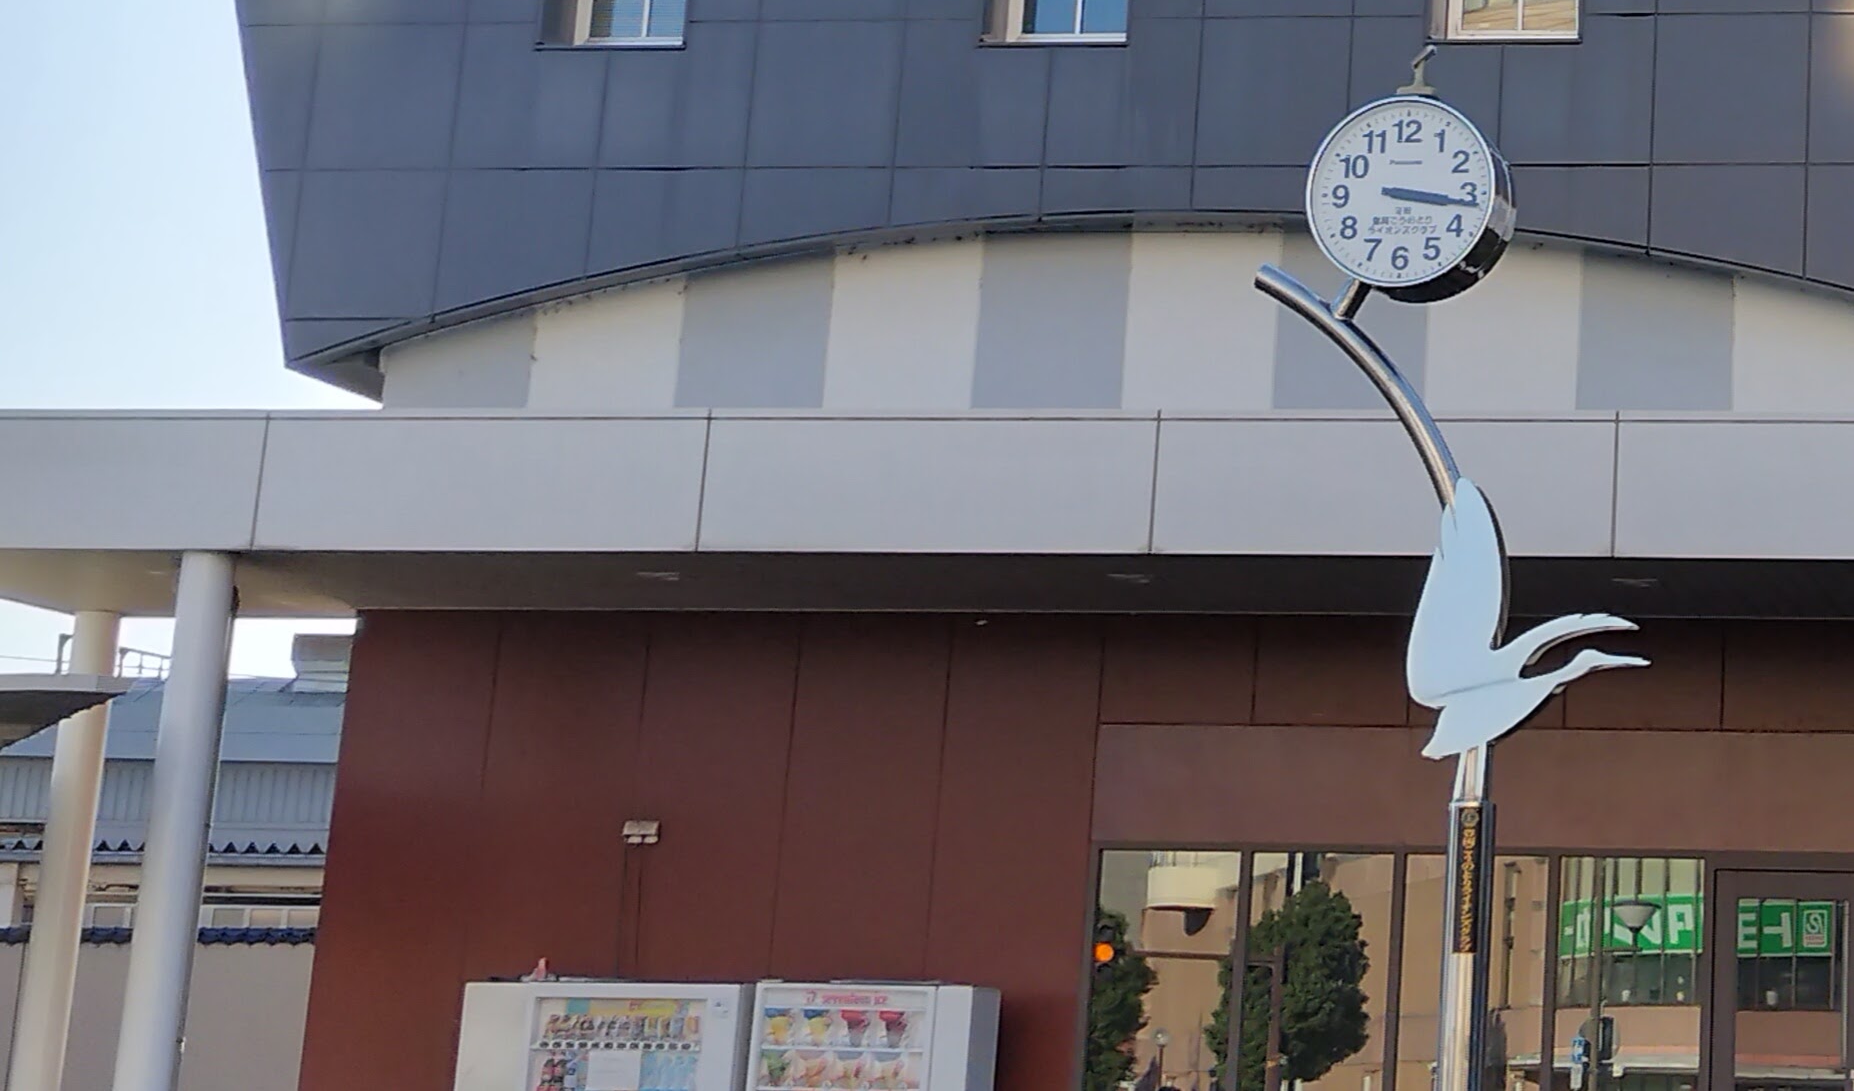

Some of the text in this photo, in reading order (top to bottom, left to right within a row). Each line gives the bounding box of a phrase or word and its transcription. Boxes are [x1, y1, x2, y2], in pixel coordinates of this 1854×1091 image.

[1363, 130, 1387, 154] 11
[1393, 119, 1422, 144] 12
[1434, 129, 1446, 153] 1
[1340, 154, 1370, 179] 10
[1452, 150, 1470, 174] 2
[1332, 184, 1350, 208] 9
[1459, 182, 1478, 205] 3
[1340, 216, 1358, 240] 8
[1446, 213, 1464, 238] 4
[1364, 238, 1382, 262] 7
[1391, 246, 1409, 271] 6
[1423, 236, 1441, 261] 5
